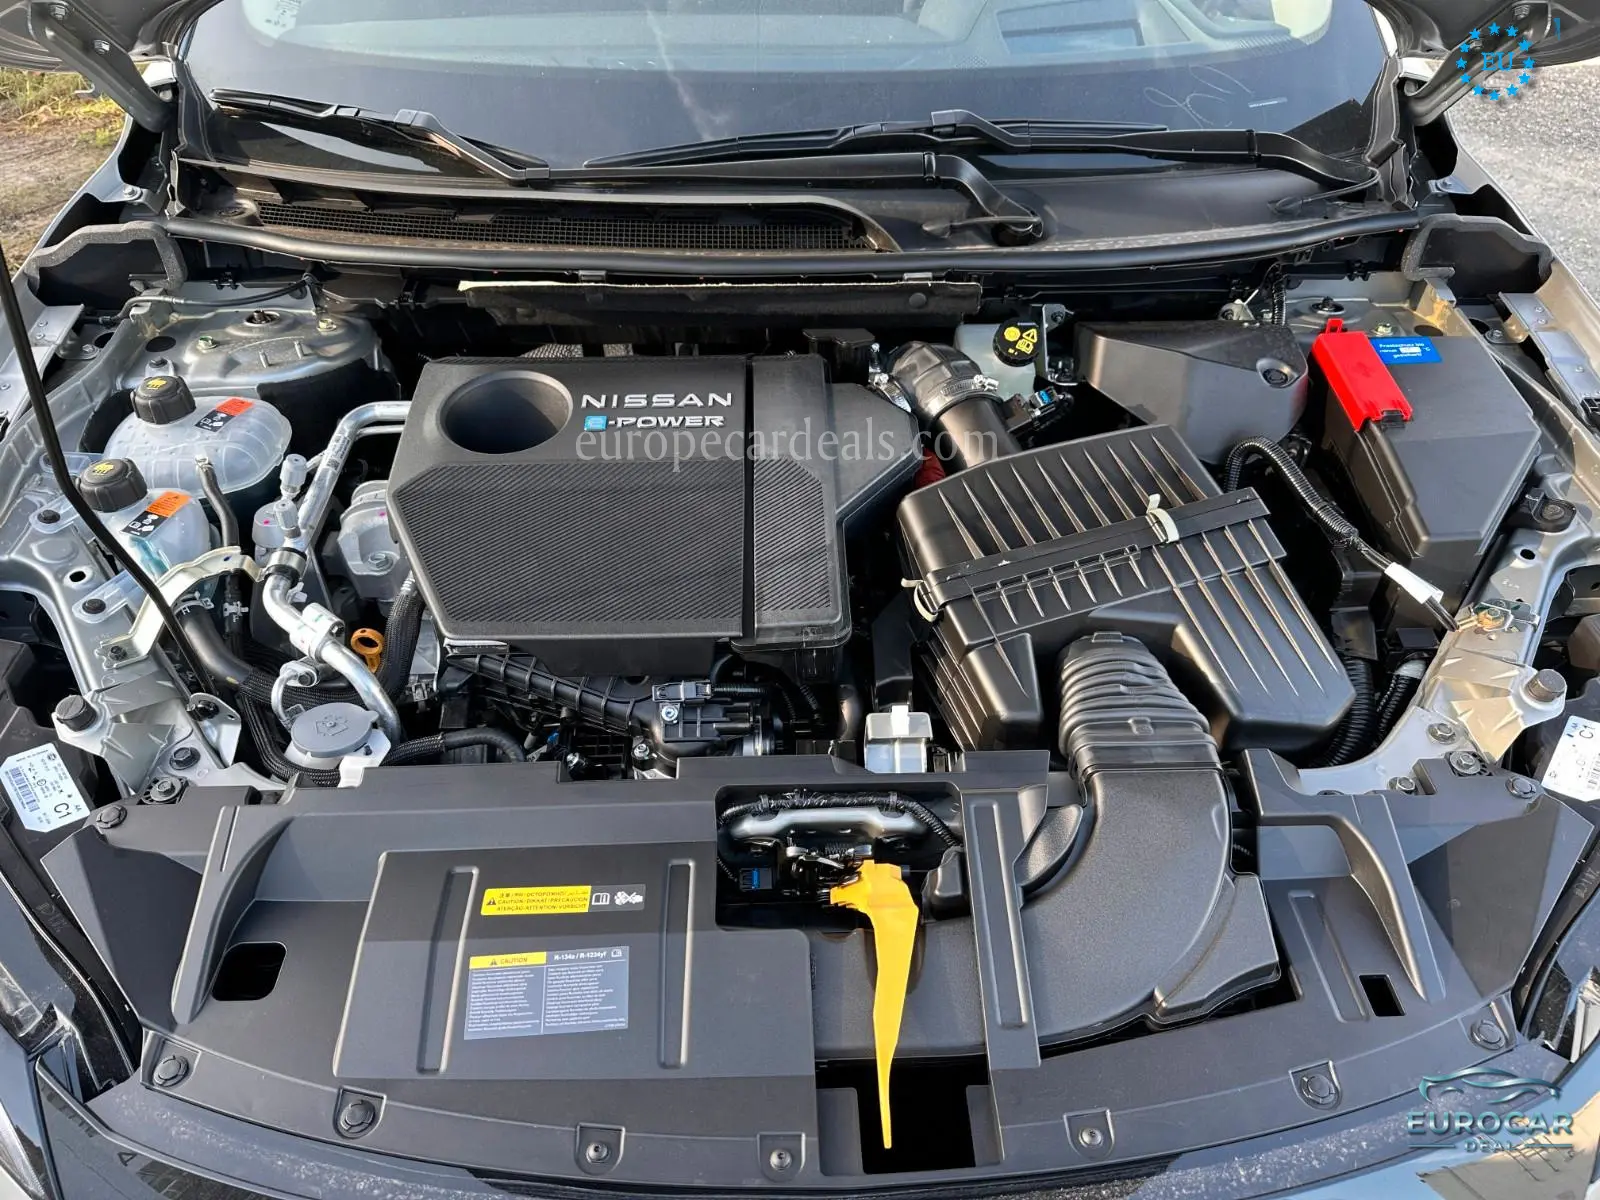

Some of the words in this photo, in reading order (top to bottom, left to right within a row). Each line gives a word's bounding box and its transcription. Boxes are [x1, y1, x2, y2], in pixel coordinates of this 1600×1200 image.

[581, 392, 732, 409] NISSAN
[54, 802, 72, 819] C1
[500, 957, 528, 965] CAUTION
